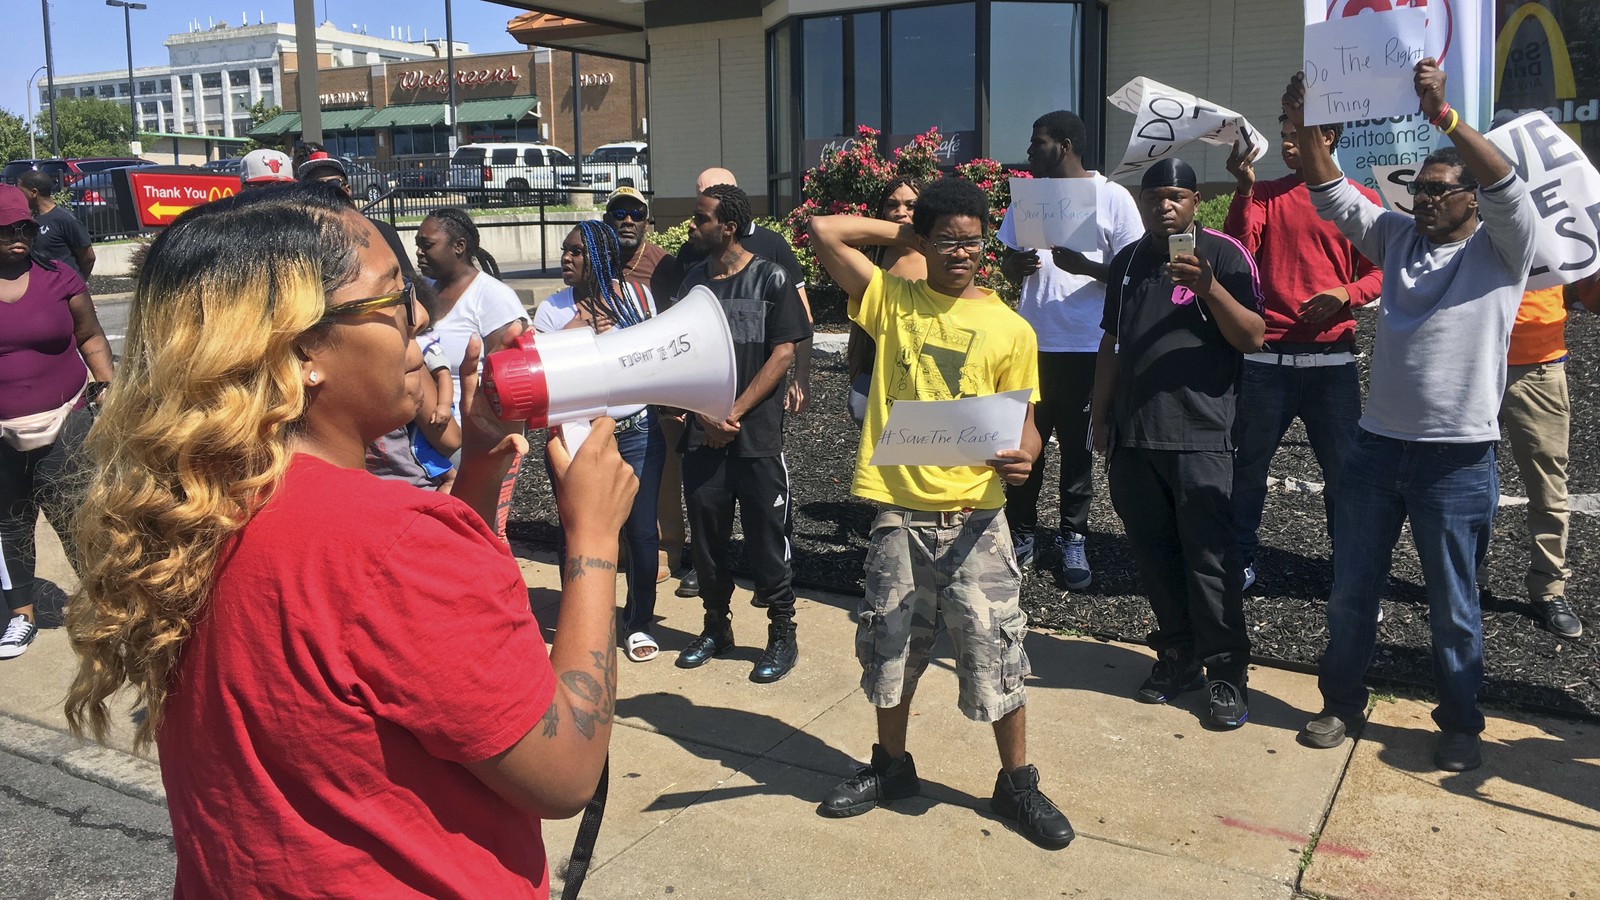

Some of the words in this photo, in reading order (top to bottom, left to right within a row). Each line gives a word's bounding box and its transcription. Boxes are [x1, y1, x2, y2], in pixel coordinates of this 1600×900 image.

[1304, 59, 1329, 88] Do
[1334, 45, 1371, 75] The
[1385, 37, 1424, 68] Right
[576, 72, 613, 87] HOTO
[319, 90, 368, 105] HARMACY
[1320, 91, 1371, 117] Thing
[143, 185, 181, 198] Thank
[183, 187, 207, 199] You
[1180, 287, 1188, 300] 7
[618, 347, 655, 368] FIGHT
[669, 333, 691, 357] 15
